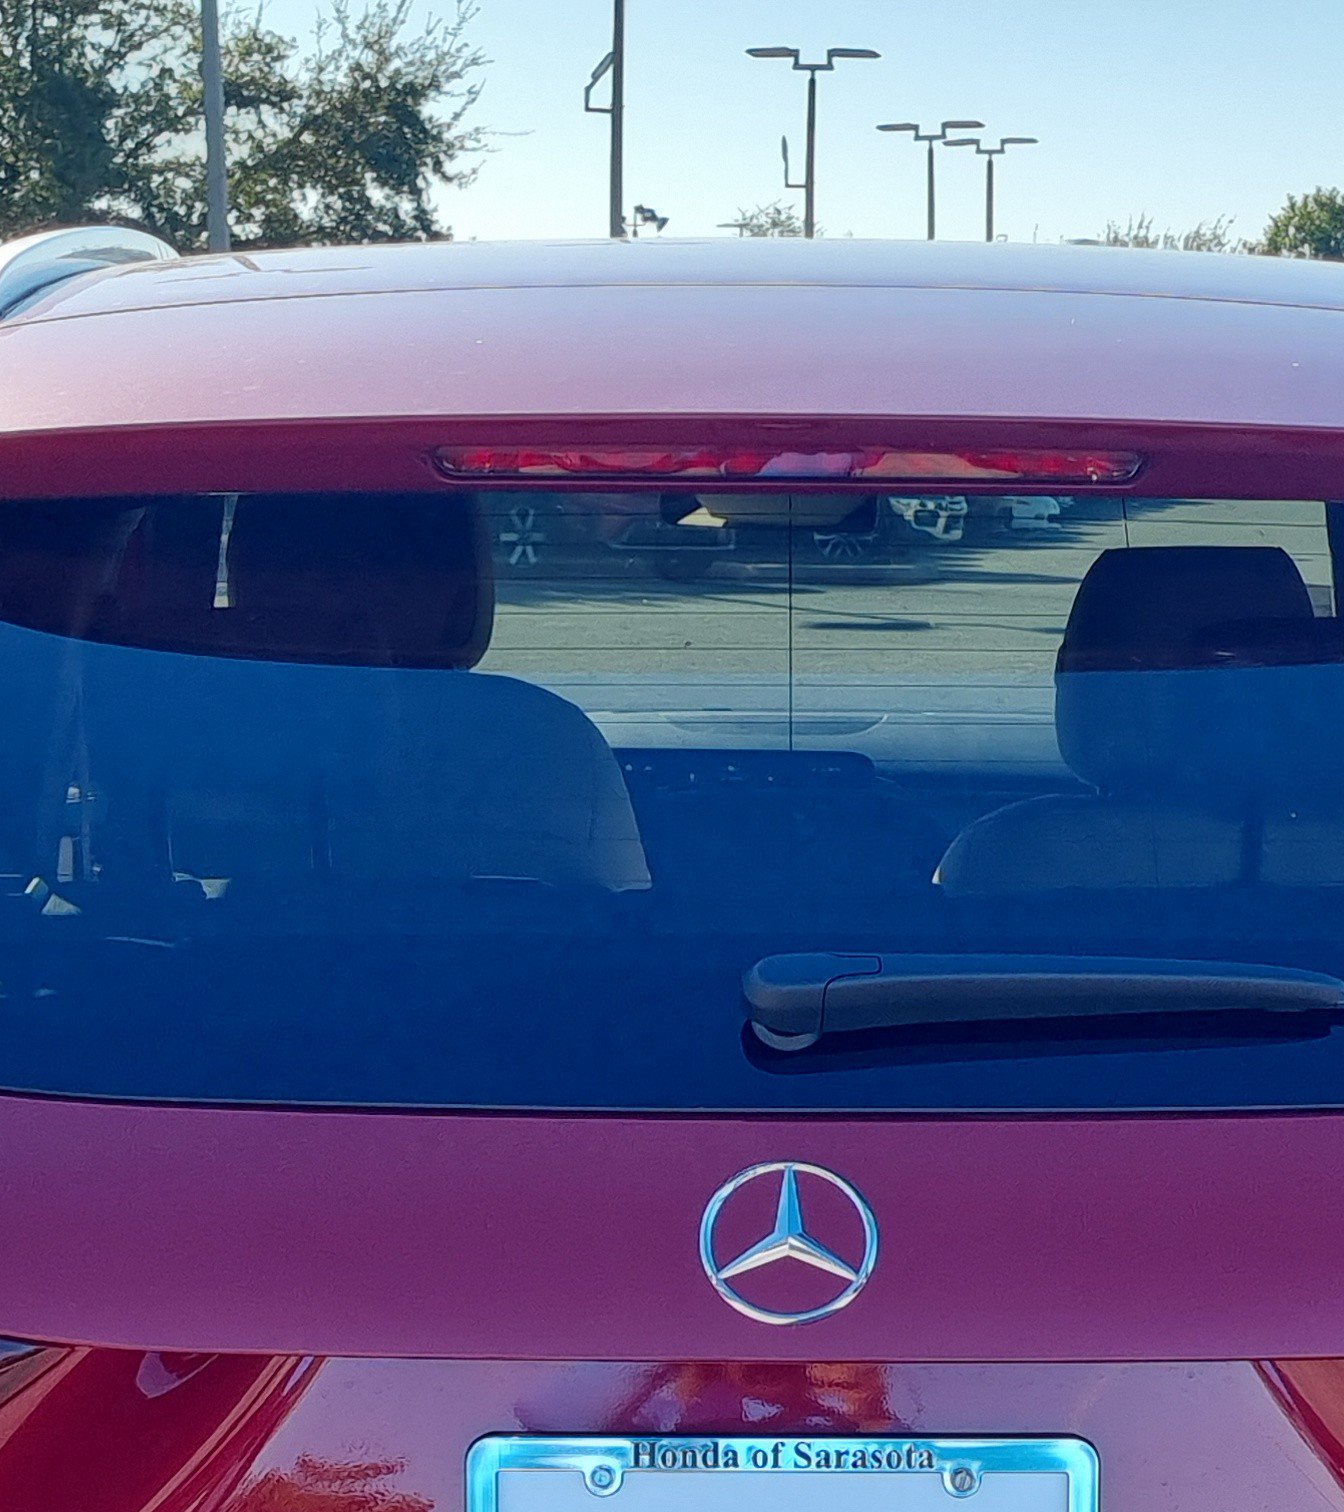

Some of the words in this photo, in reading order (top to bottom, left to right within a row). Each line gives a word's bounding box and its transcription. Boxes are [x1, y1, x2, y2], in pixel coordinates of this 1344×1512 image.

[629, 1441, 739, 1469] Honda
[751, 1441, 785, 1469] of
[793, 1441, 936, 1470] Sarasota
